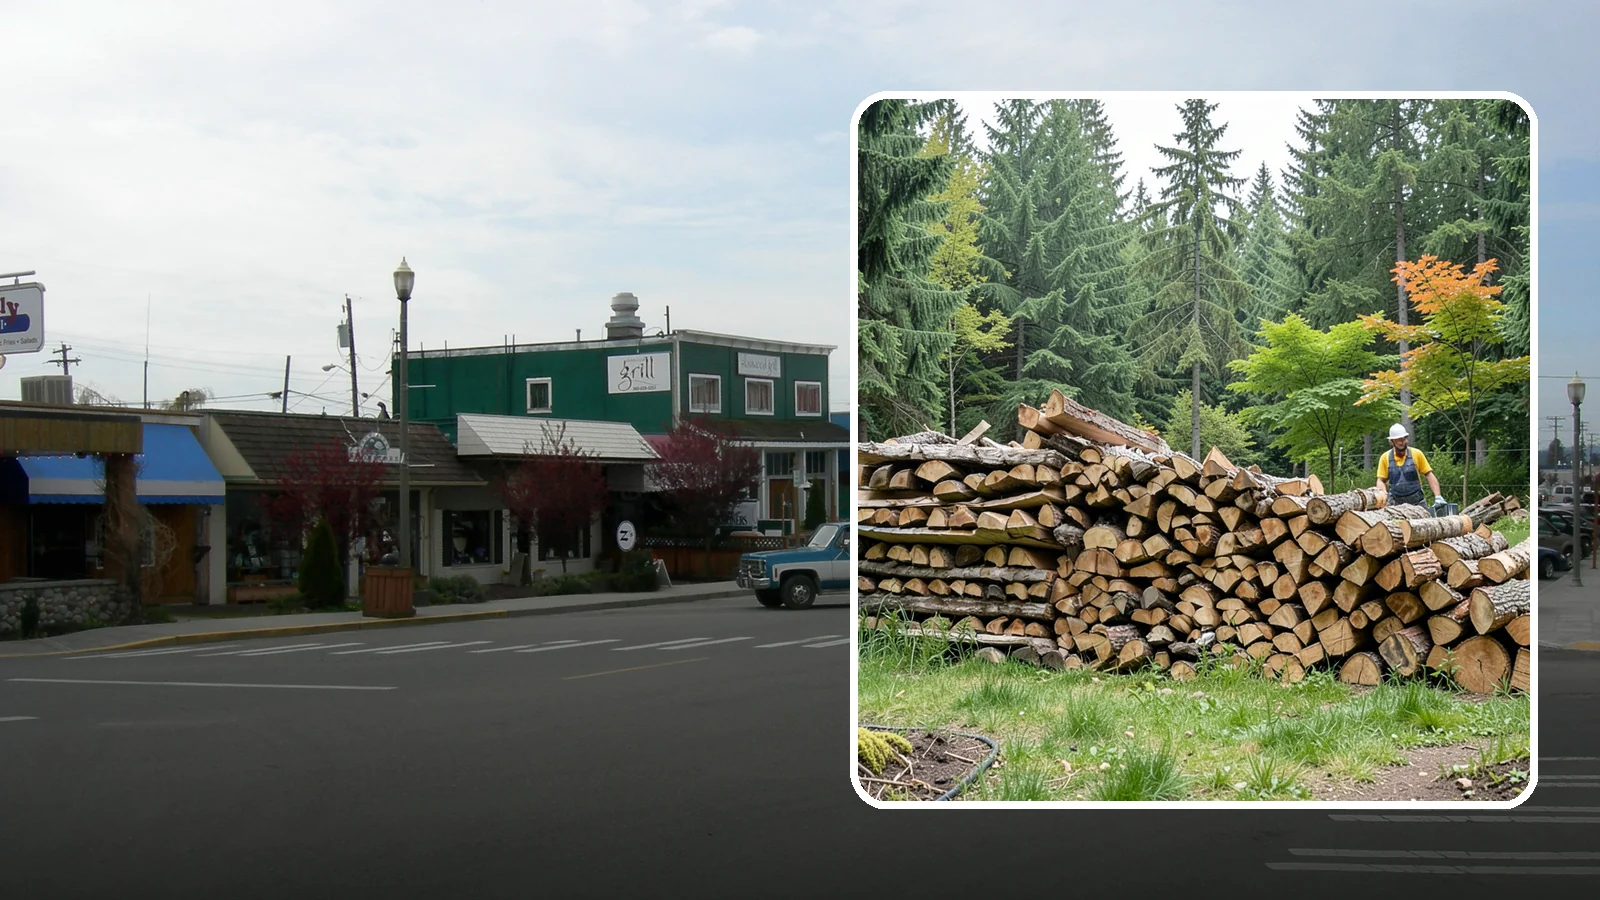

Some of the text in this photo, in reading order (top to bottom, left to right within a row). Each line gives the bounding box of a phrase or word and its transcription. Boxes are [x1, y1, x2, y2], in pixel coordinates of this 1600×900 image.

[0, 296, 20, 325] ly
[20, 337, 38, 345] Salads
[618, 356, 655, 391] grill
